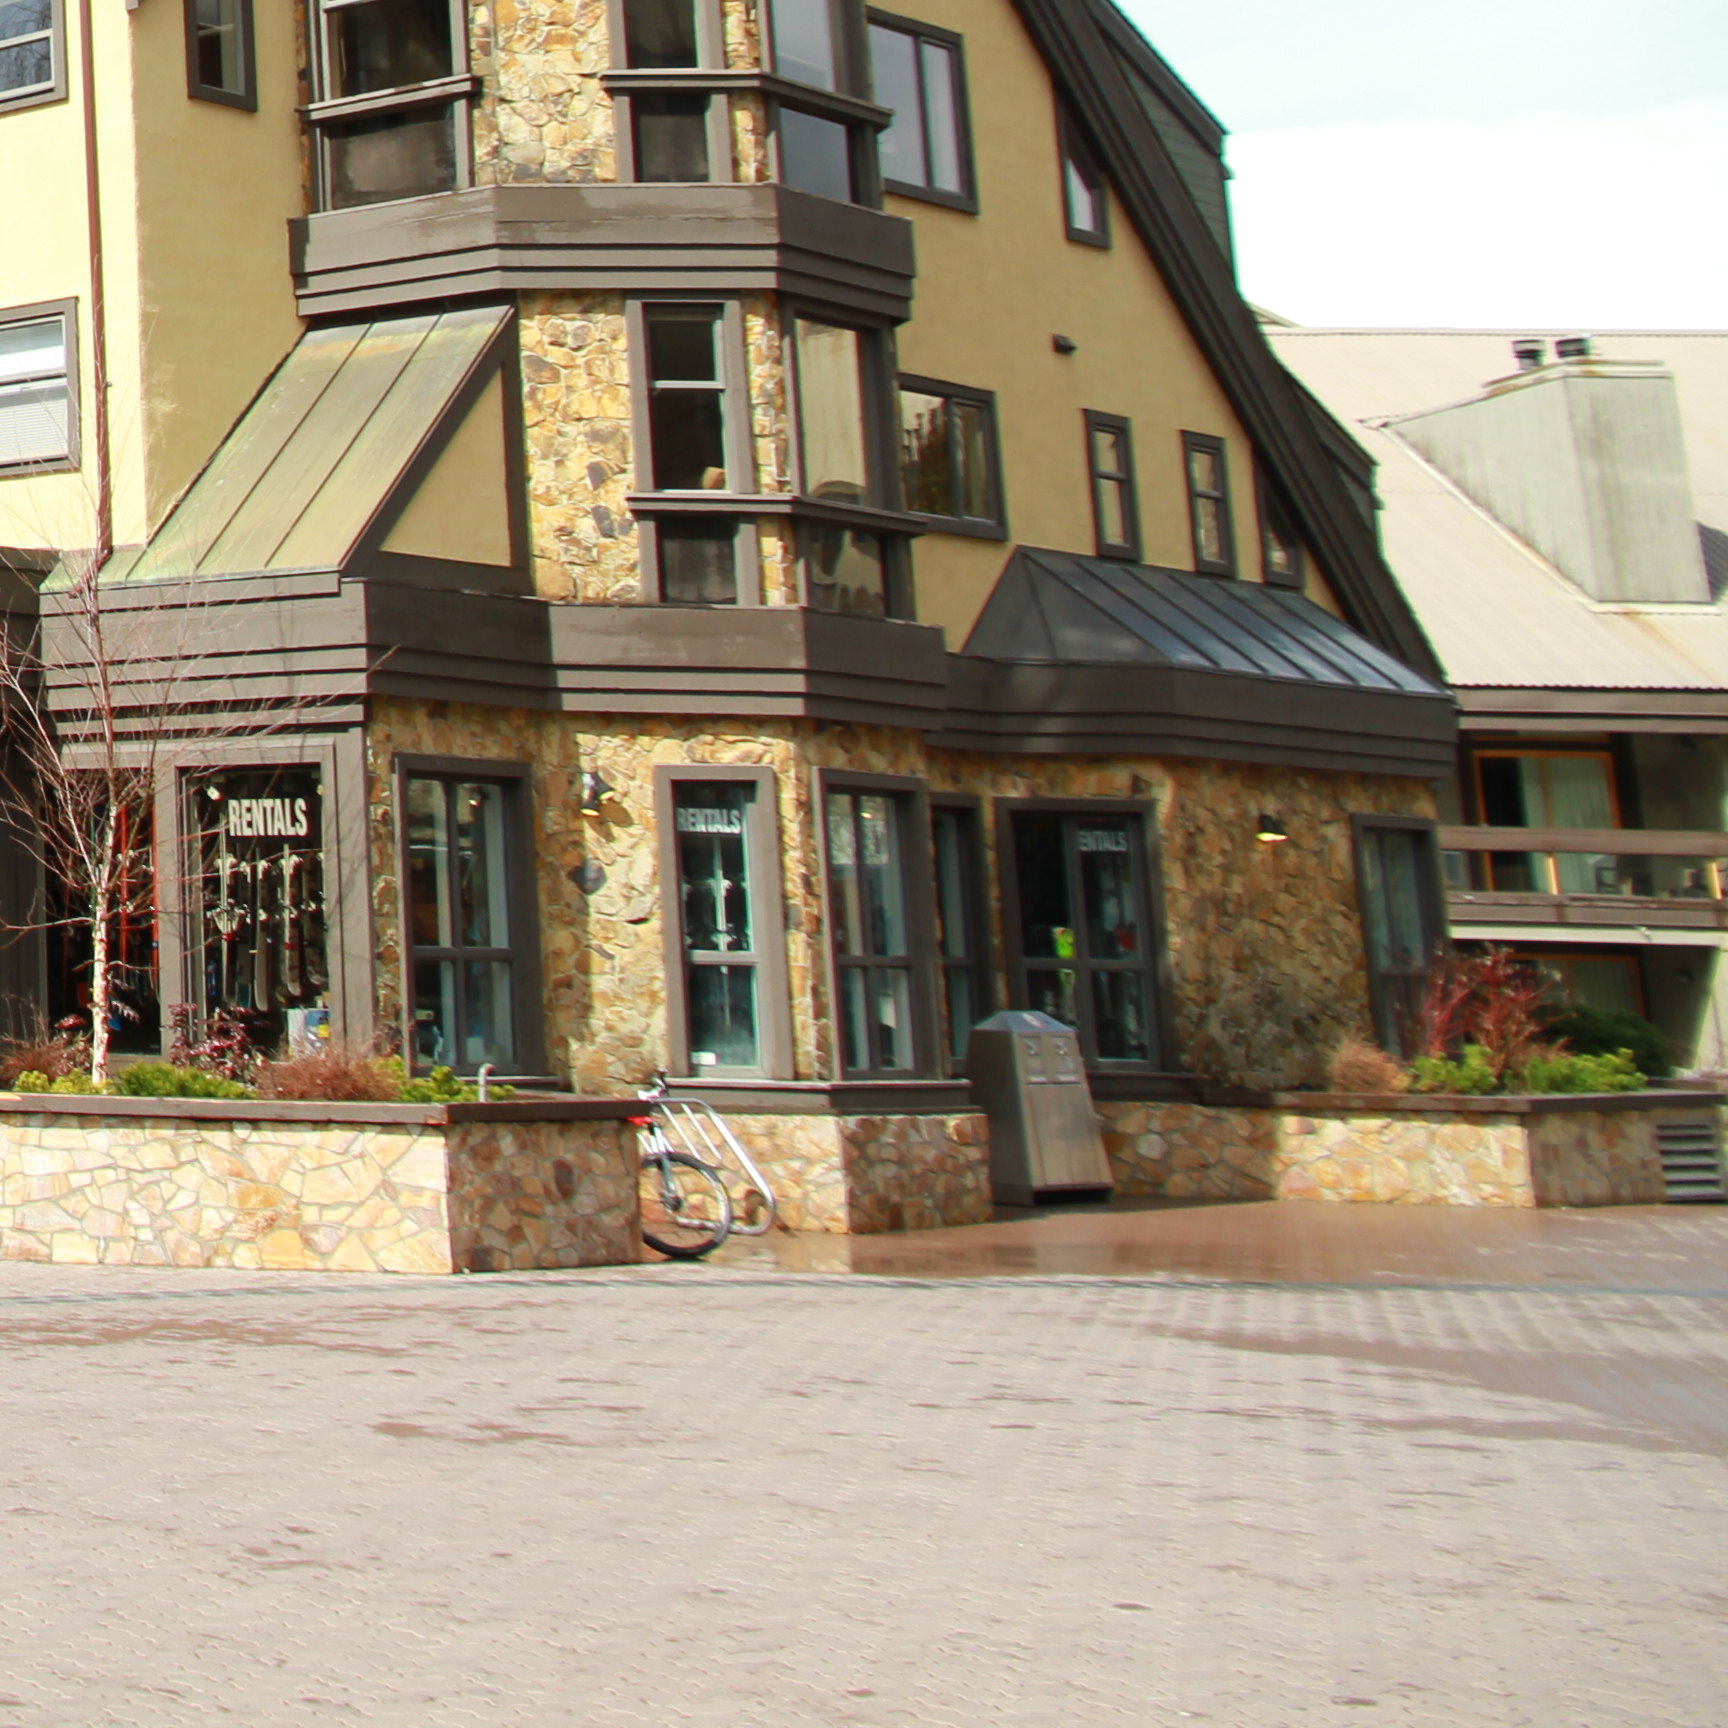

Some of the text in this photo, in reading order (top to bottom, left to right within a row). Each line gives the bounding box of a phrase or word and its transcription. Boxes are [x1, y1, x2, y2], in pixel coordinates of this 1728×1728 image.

[228, 797, 307, 837] RENTALS
[676, 807, 742, 834] RENTALS
[1077, 830, 1129, 852] ENTALS
